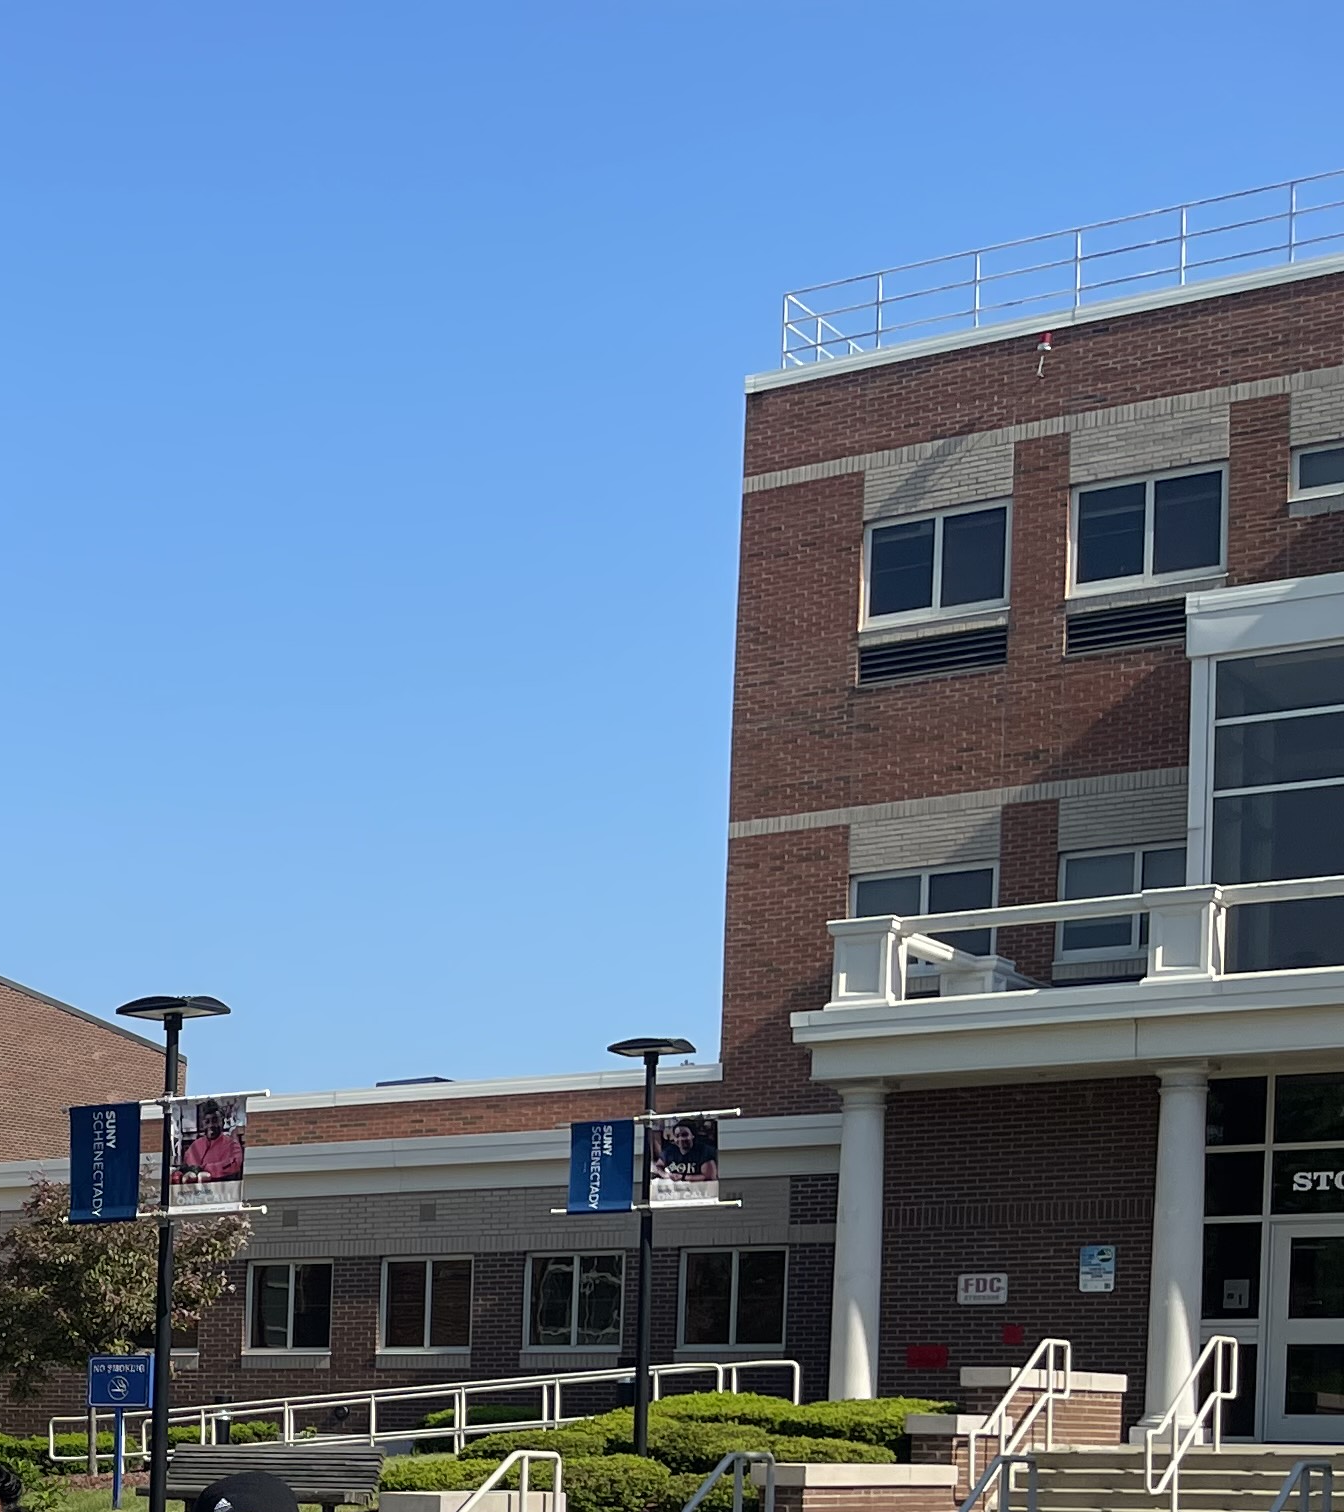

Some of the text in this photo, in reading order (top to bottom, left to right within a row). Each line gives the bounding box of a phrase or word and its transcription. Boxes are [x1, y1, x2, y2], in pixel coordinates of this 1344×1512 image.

[105, 1110, 116, 1149] SUNY
[603, 1125, 612, 1156] SUNY
[92, 1111, 104, 1217] SCHENECTADY
[588, 1126, 602, 1210] SCHENECTADY
[964, 1277, 1002, 1293] FDC
[93, 1364, 145, 1374] NO SMOKING
